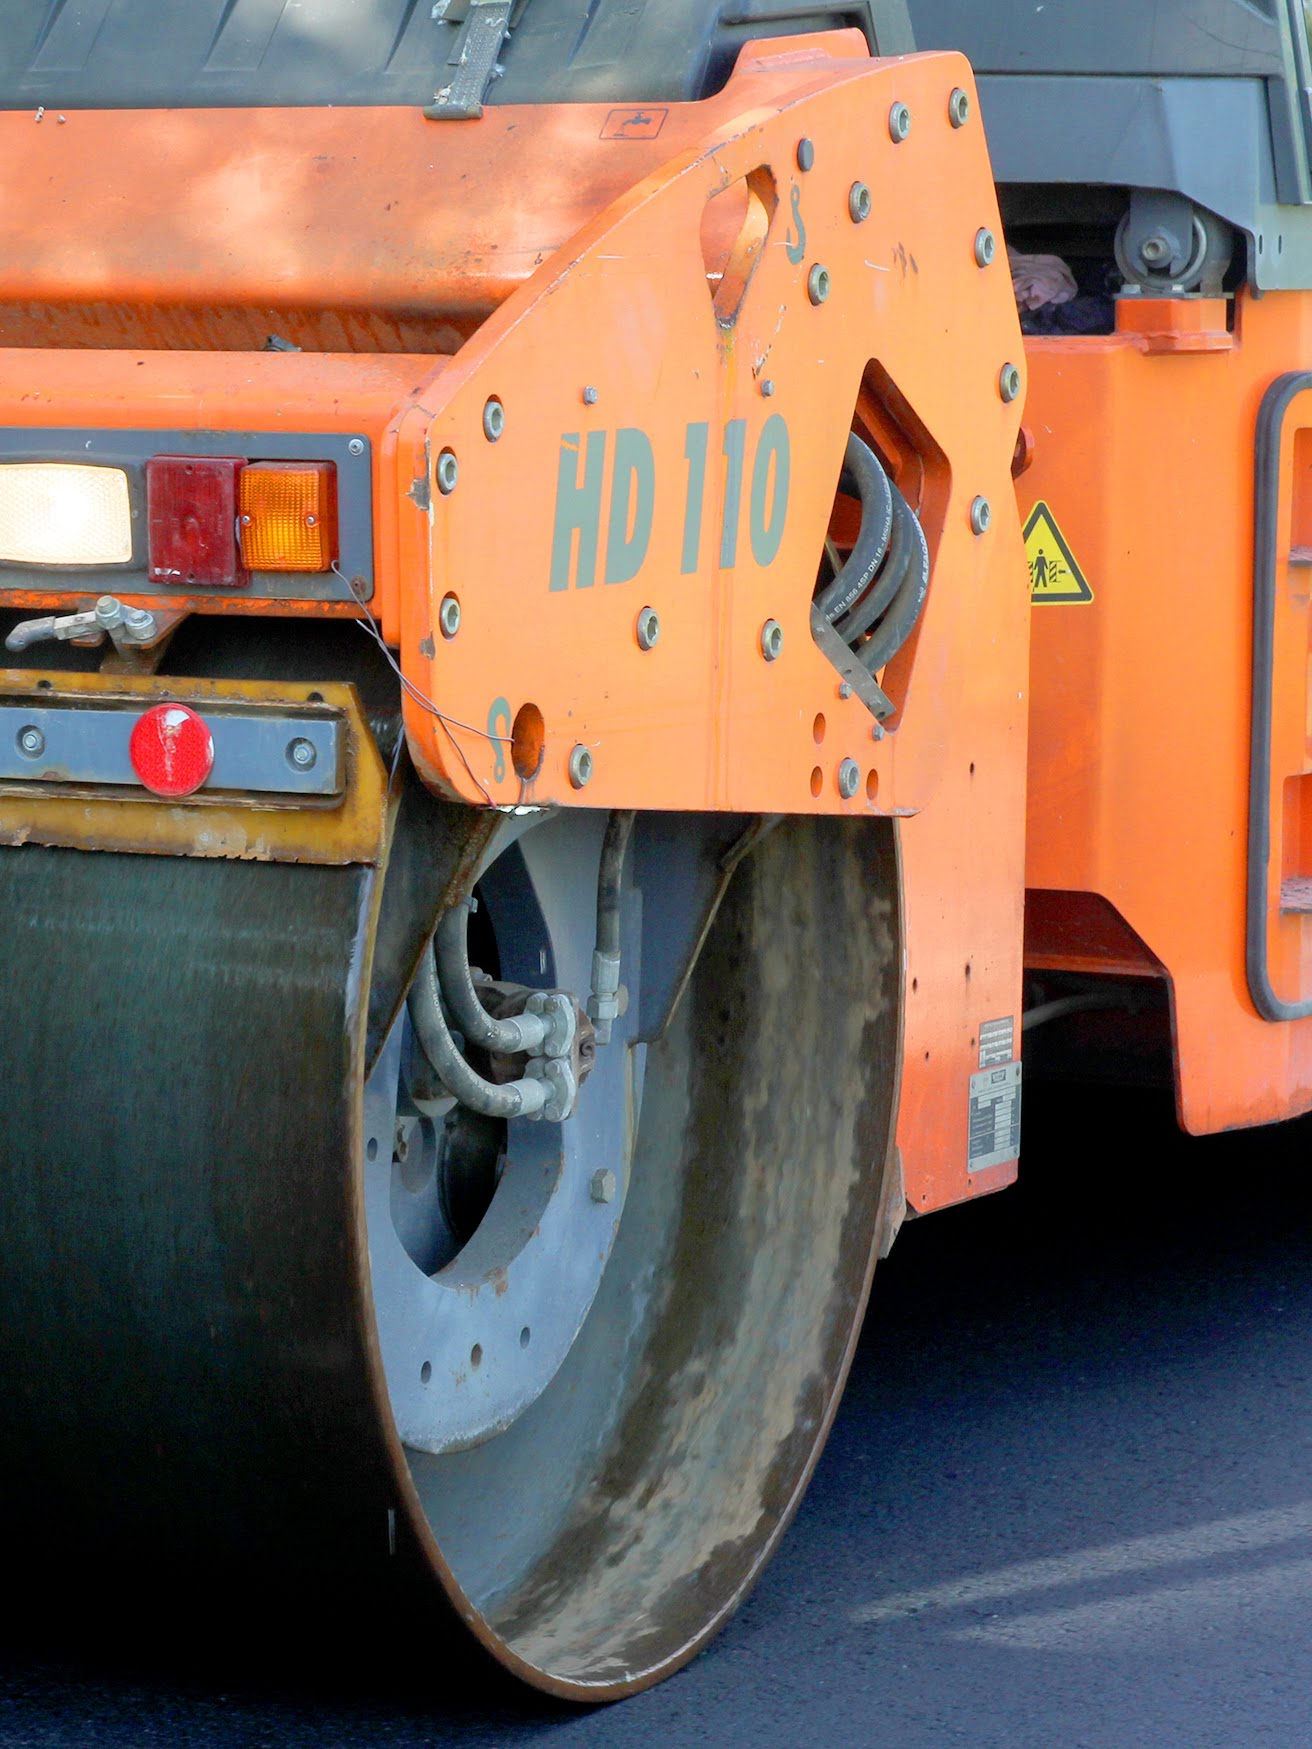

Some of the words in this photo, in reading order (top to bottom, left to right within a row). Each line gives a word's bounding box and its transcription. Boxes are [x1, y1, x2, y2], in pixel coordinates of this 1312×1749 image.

[549, 427, 655, 592] HD
[681, 413, 791, 575] 110
[834, 601, 847, 614] EN
[857, 571, 869, 588] 4SP
[868, 559, 878, 572] DN
